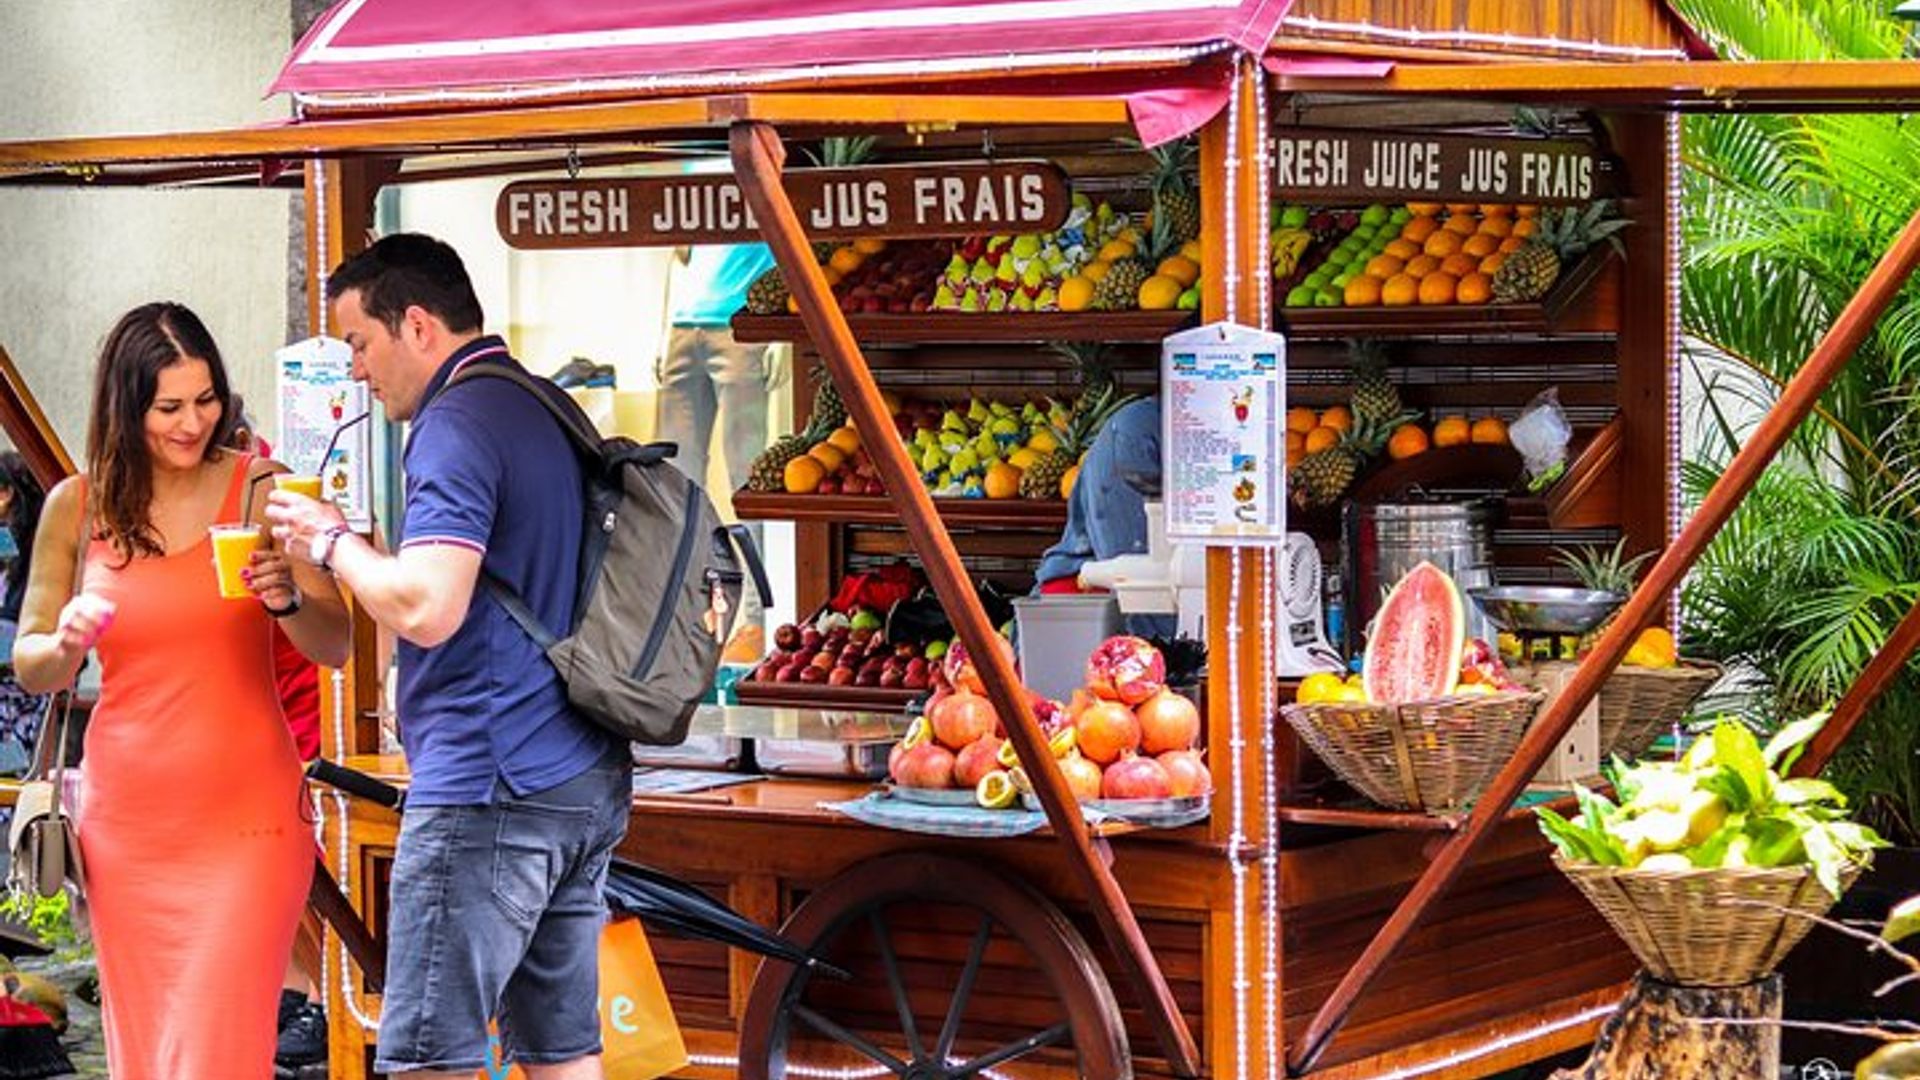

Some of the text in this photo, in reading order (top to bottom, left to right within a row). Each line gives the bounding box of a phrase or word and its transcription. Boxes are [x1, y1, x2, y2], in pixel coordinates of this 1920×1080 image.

[1363, 141, 1440, 191] JUICE
[1460, 148, 1508, 194] JUS
[1521, 153, 1593, 199] FRAIS
[508, 187, 629, 235] FRESH
[811, 182, 889, 229] JUS
[914, 173, 1045, 223] FRAIS
